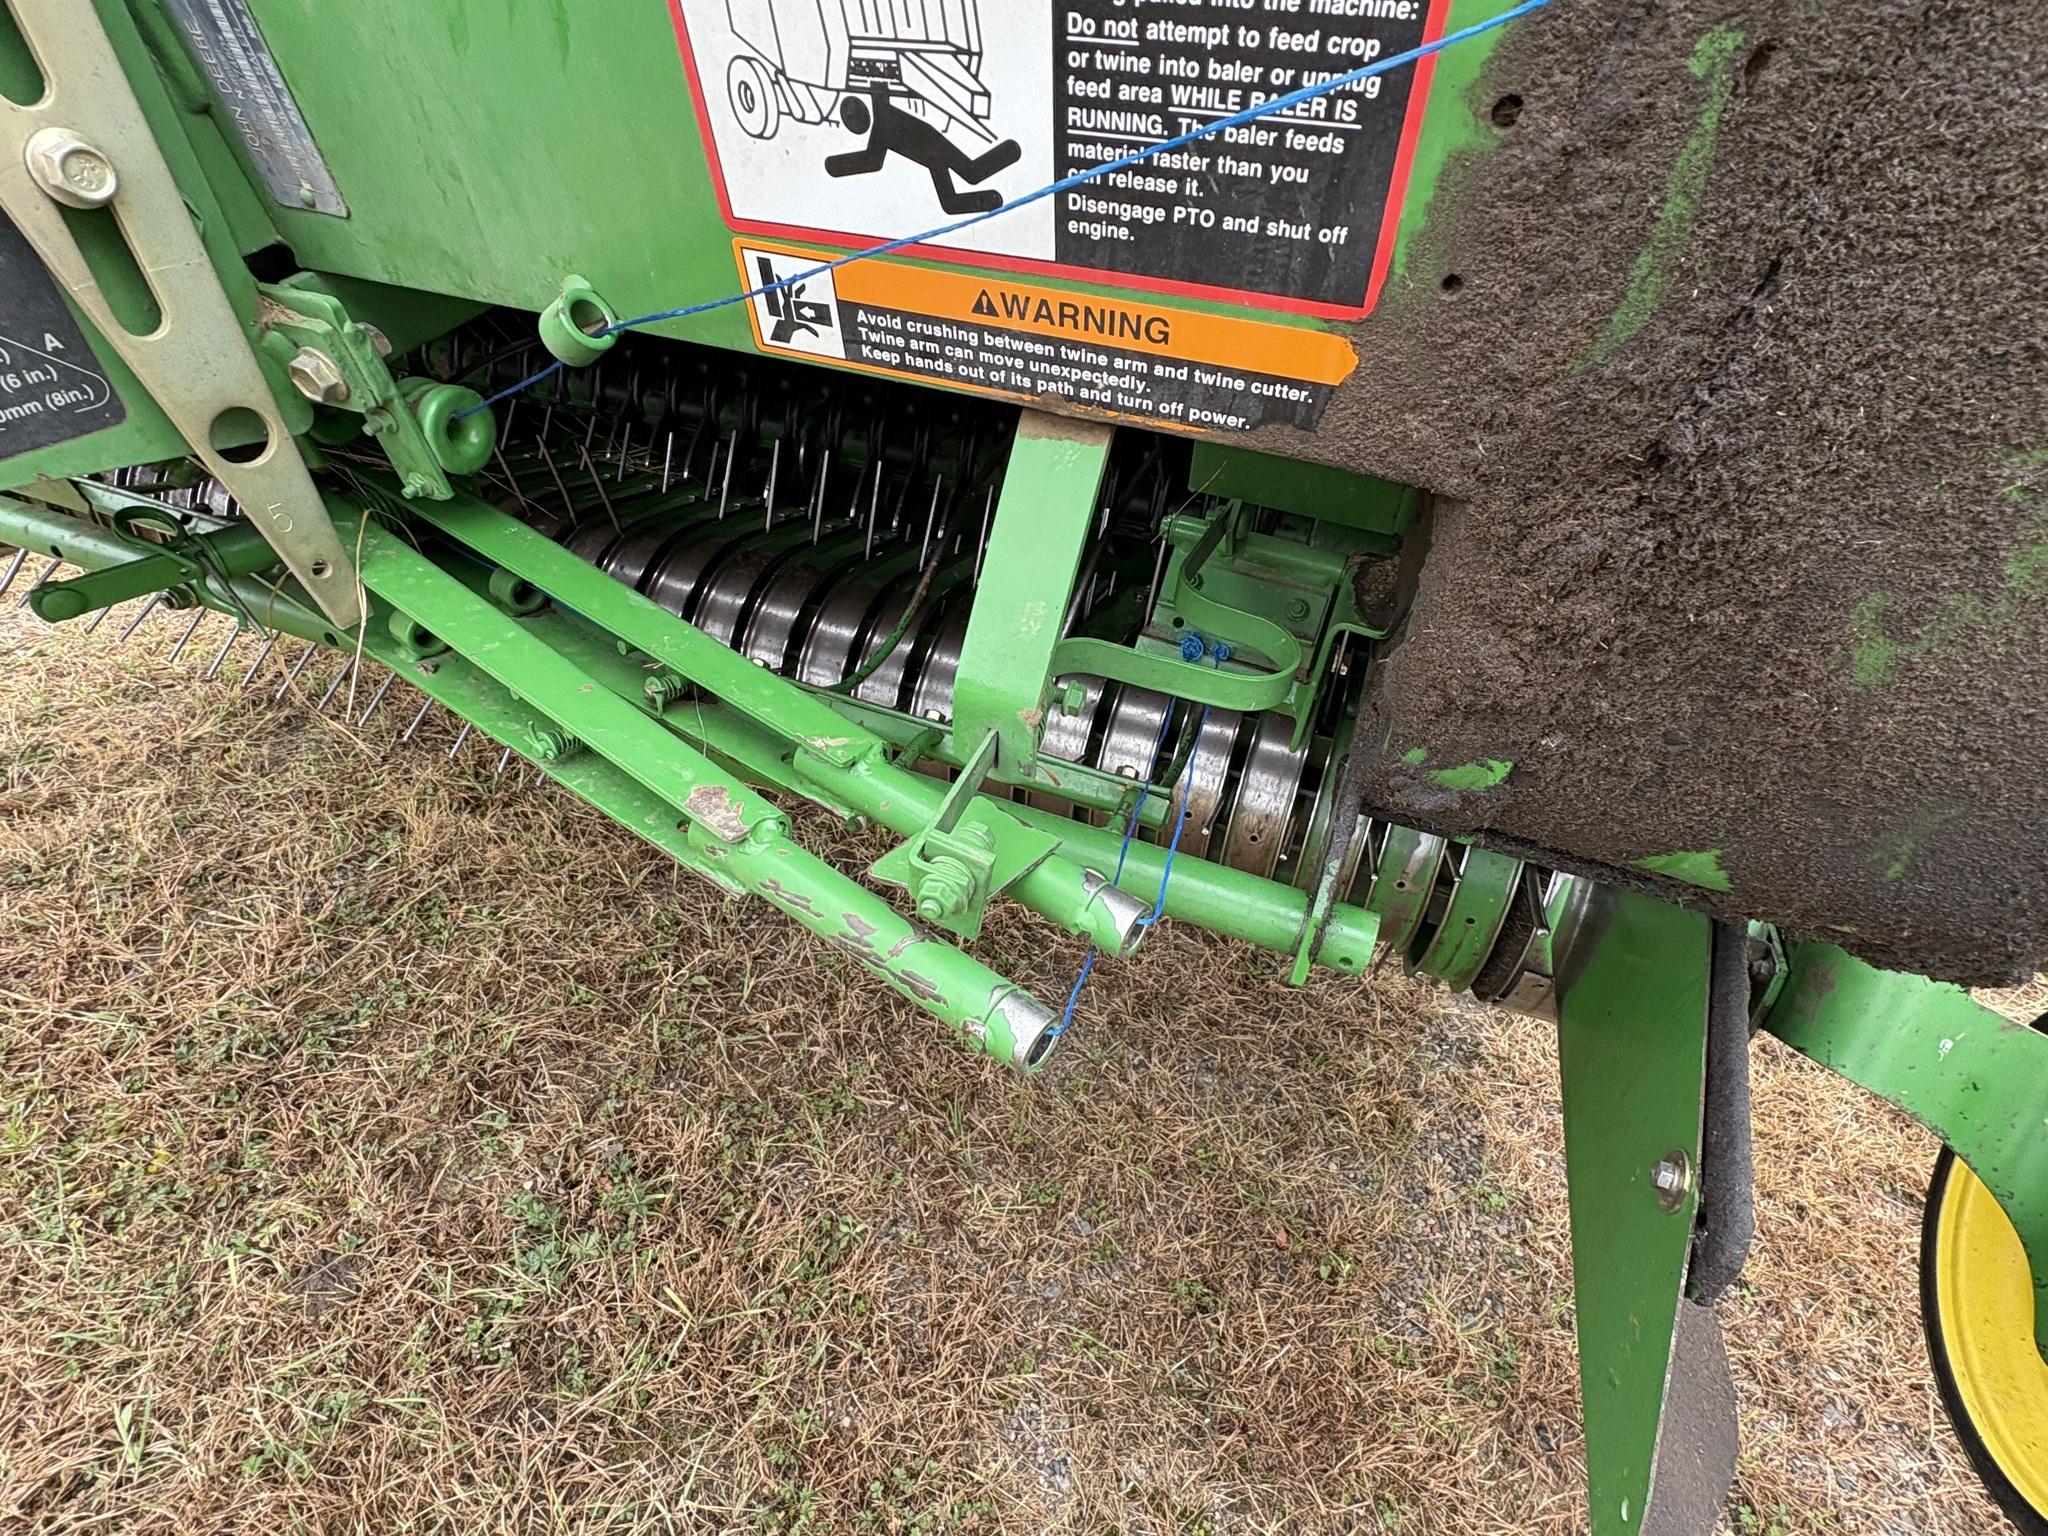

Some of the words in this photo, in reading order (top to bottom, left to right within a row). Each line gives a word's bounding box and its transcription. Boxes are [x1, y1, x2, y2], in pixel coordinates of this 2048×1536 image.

[1309, 0, 1419, 20] machine:
[183, 19, 232, 93] DEERE
[1067, 11, 1096, 35] Do
[1104, 17, 1138, 39] not
[1146, 19, 1230, 50] attempt
[1238, 25, 1260, 48] to
[1269, 26, 1320, 53] feed
[1327, 34, 1381, 62] crop
[1068, 50, 1089, 68] or
[1095, 49, 1151, 74] twine
[1159, 53, 1200, 78] into
[1208, 57, 1263, 83] baler
[1270, 67, 1295, 86] or
[1067, 75, 1111, 99] feed
[1118, 83, 1163, 104] area
[1171, 83, 1242, 111] WHILE
[1335, 98, 1358, 122] IS
[231, 106, 266, 158] JOHN
[1067, 106, 1169, 136] RUNNING.
[1224, 124, 1278, 147] baler
[1285, 128, 1345, 154] feeds
[1067, 141, 1145, 165] material
[1152, 150, 1210, 172] faster
[1217, 155, 1263, 178] than
[1270, 163, 1309, 185] you
[1067, 167, 1101, 185] cn
[1108, 170, 1178, 194] release
[1185, 177, 1204, 197] it.
[1068, 193, 1166, 225] Disengage
[1173, 206, 1216, 228] PTO
[1222, 215, 1260, 234] and
[1266, 219, 1312, 241] shut
[1318, 226, 1349, 245] off
[1068, 219, 1135, 241] engine.
[999, 291, 1170, 345] WARNING
[44, 333, 65, 352] A
[857, 309, 902, 330] Avoid
[906, 320, 979, 346] crushing
[984, 331, 1055, 357] between
[1060, 345, 1108, 367] twine
[1113, 357, 1148, 374] arm
[1154, 363, 1188, 381] and
[1194, 369, 1245, 391] twine
[1251, 381, 1313, 404] cutter.
[858, 327, 905, 348] Twine
[909, 338, 940, 354] arm
[945, 345, 974, 360] can
[979, 352, 1025, 370] move
[1029, 360, 1151, 393] unexpectedly.
[22, 363, 58, 382] in.)
[861, 344, 901, 365] Keep
[905, 352, 953, 374] hands
[958, 363, 985, 379] out
[989, 369, 1006, 384] of
[1011, 372, 1032, 388] its
[1037, 378, 1074, 397] path
[1079, 385, 1111, 404] and
[1117, 391, 1153, 411] turn
[1159, 401, 1184, 417] off
[1189, 407, 1250, 430] power.
[45, 383, 94, 412] (8in.)
[267, 502, 293, 533] 5
